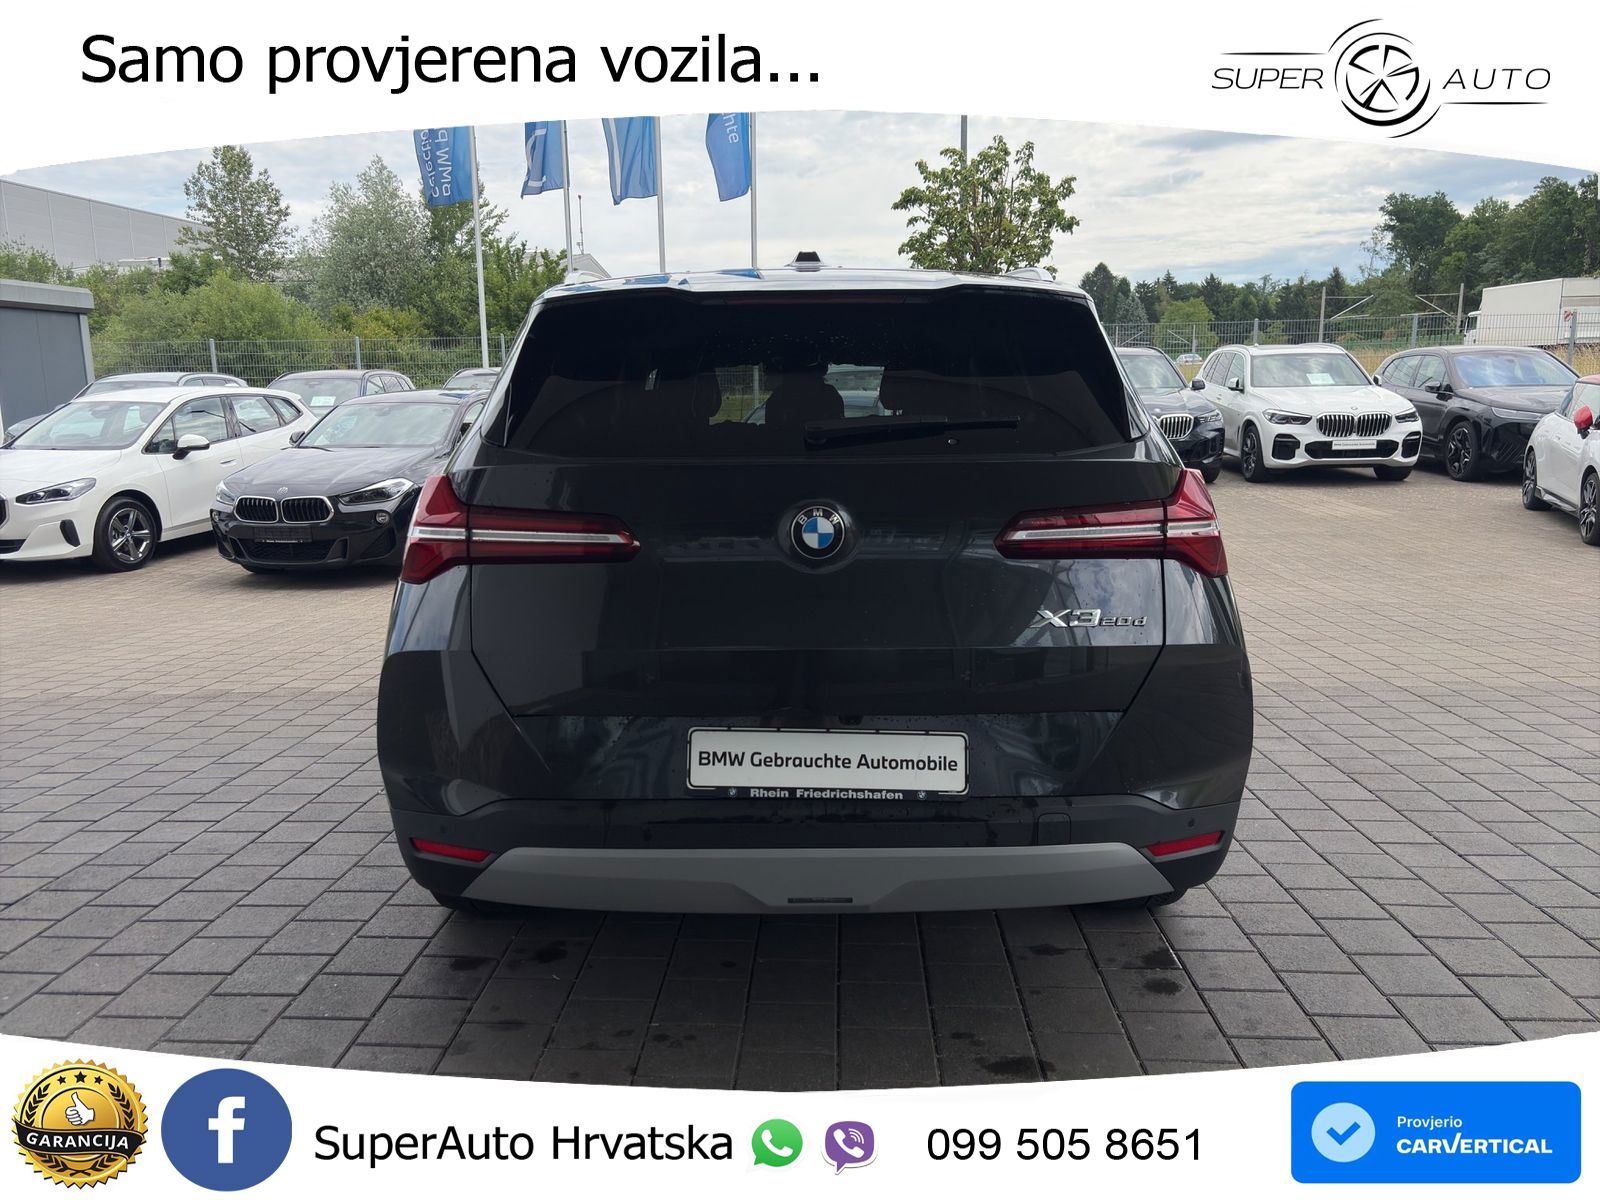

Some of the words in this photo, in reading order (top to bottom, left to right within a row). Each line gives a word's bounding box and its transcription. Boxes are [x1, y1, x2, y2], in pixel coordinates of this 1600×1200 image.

[797, 508, 840, 525] BMW
[698, 750, 746, 767] BMW
[750, 751, 852, 769] Gebrauchte
[856, 753, 958, 772] Automobile
[750, 788, 790, 799] Rhein
[796, 788, 904, 800] Friedrichshafen
